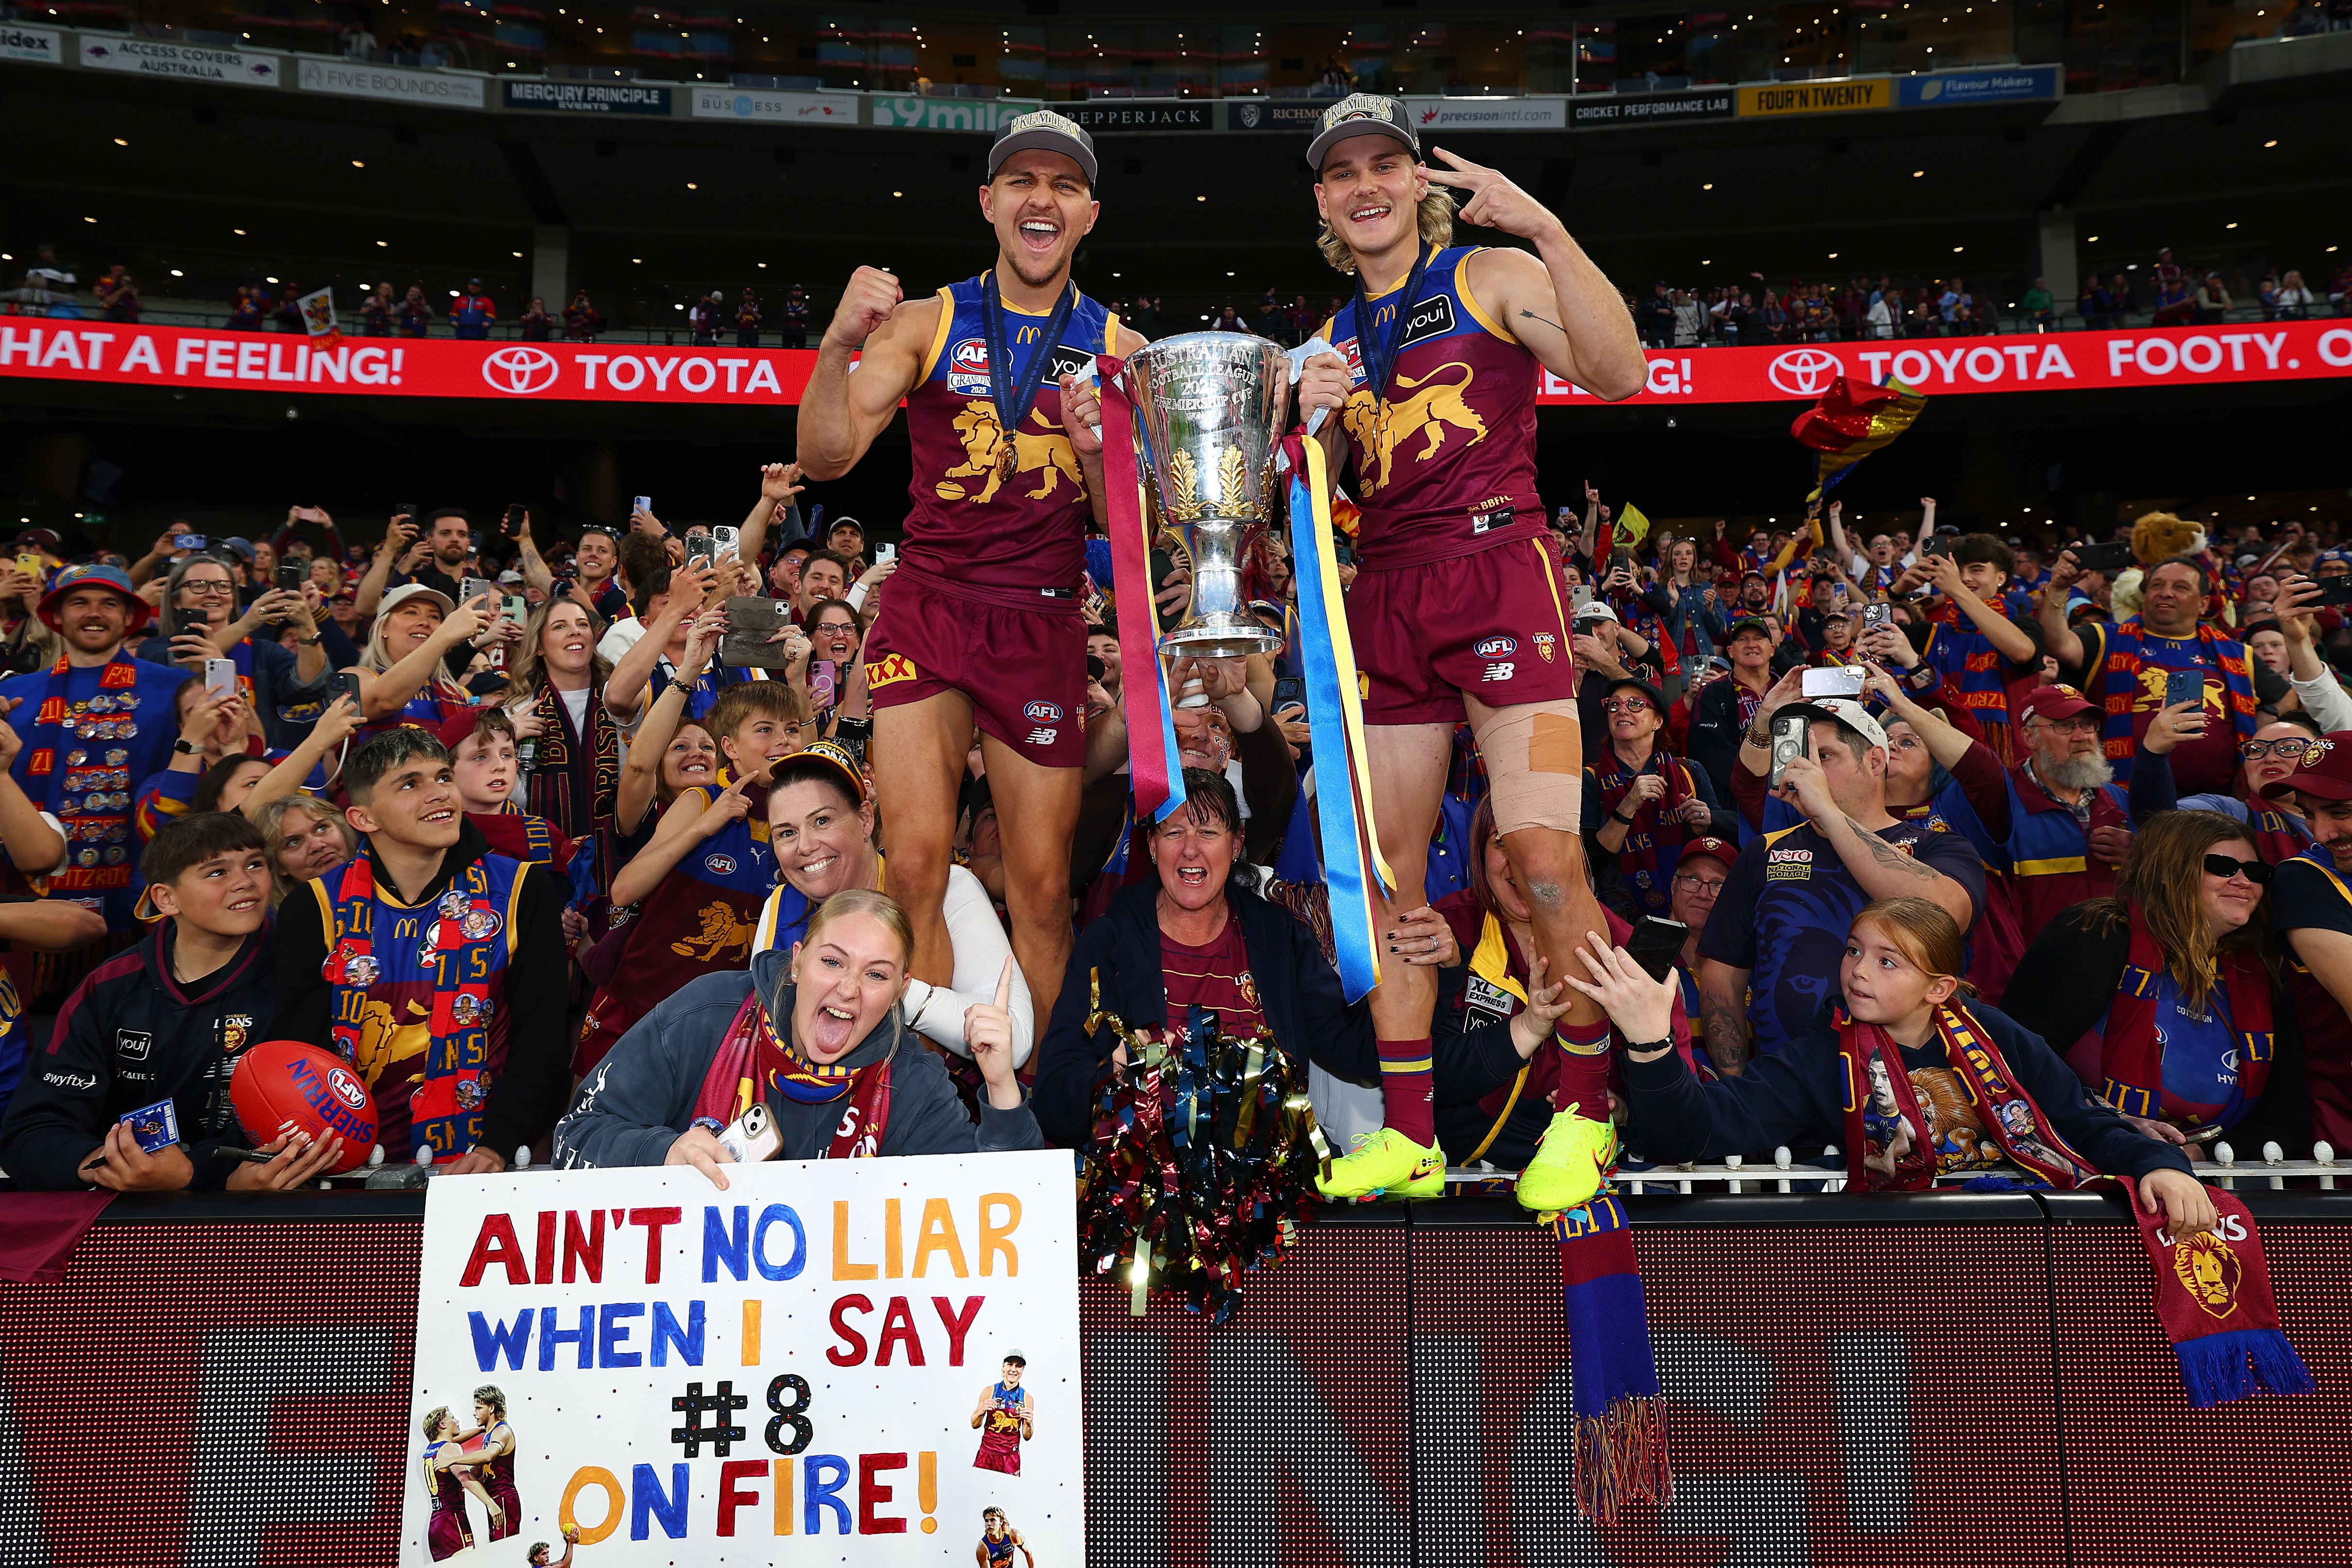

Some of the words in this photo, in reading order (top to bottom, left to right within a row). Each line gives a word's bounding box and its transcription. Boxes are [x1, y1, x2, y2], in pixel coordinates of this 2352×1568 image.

[119, 42, 176, 58] ACCESS
[181, 49, 242, 66] COVERS
[139, 59, 222, 78] AUSTRALIA
[328, 70, 368, 88] FIVE
[371, 75, 448, 96] BOUNDS
[511, 82, 585, 102] MERCURY
[587, 86, 660, 104] PRINCIPLE
[1945, 80, 1990, 91] Flavour
[1991, 76, 2033, 89] Makers
[558, 100, 610, 111] EVENTS
[702, 99, 781, 113] BUSINESS
[1759, 90, 1808, 110] FOUR'N
[1813, 85, 1873, 106] TWENTY
[1066, 111, 1202, 126] PEPPERJACK
[1272, 108, 1325, 118] RICHMO
[1324, 97, 1393, 132] PREMIERS
[1439, 109, 1551, 124] precisionintl.com
[1576, 106, 1621, 120] CRICKET
[1624, 100, 1702, 117] PERFORMANCE
[1705, 98, 1728, 111] LAB
[1010, 111, 1081, 140] PREMIERS
[1407, 302, 1444, 339] youi
[0, 325, 115, 371] HAT
[119, 334, 162, 374] A
[174, 337, 404, 386] FEELING!
[956, 345, 989, 364] AF
[1149, 341, 1253, 375] AUSTRALIAN
[1859, 343, 2076, 387] TOYOTA
[2107, 331, 2301, 378] FOOTY.
[574, 354, 782, 394] TOYOTA
[950, 374, 979, 387] GRAND
[980, 375, 991, 385] FIN
[1145, 361, 1204, 394] FOOTBALL
[1209, 363, 1257, 386] LEAGUE
[970, 386, 987, 394] 2025
[1181, 379, 1219, 396] 2025
[1153, 394, 1229, 411] PREMIERSHIP
[1231, 387, 1253, 405] CUP
[1478, 639, 1512, 653] AFL
[1532, 634, 1556, 644] LIONS
[1027, 705, 1059, 719] AFL
[812, 743, 845, 757] BRISBANE
[524, 815, 553, 865] LION
[707, 857, 735, 871] AFL
[1771, 850, 1811, 862] vero
[53, 866, 131, 887] FITZROY
[1768, 865, 1810, 873] NATIONAL
[1470, 979, 1491, 995] XL
[1468, 991, 1507, 1009] EXPRESS
[213, 1017, 253, 1029] LONS
[119, 1037, 148, 1052] youi
[43, 1072, 85, 1087] swyftx
[334, 1070, 365, 1103] AFL
[286, 1057, 375, 1144] SHERRIN
[459, 1206, 682, 1287] AIN'T
[702, 1203, 806, 1283] NO
[832, 1192, 1022, 1281] LIAR
[2156, 1214, 2248, 1248] LNS
[467, 1300, 706, 1372] WHEN
[741, 1299, 762, 1367] I
[825, 1293, 987, 1368] SAY
[671, 1373, 814, 1458] #8
[559, 1463, 689, 1546] ON
[716, 1451, 938, 1538] FIRE!
